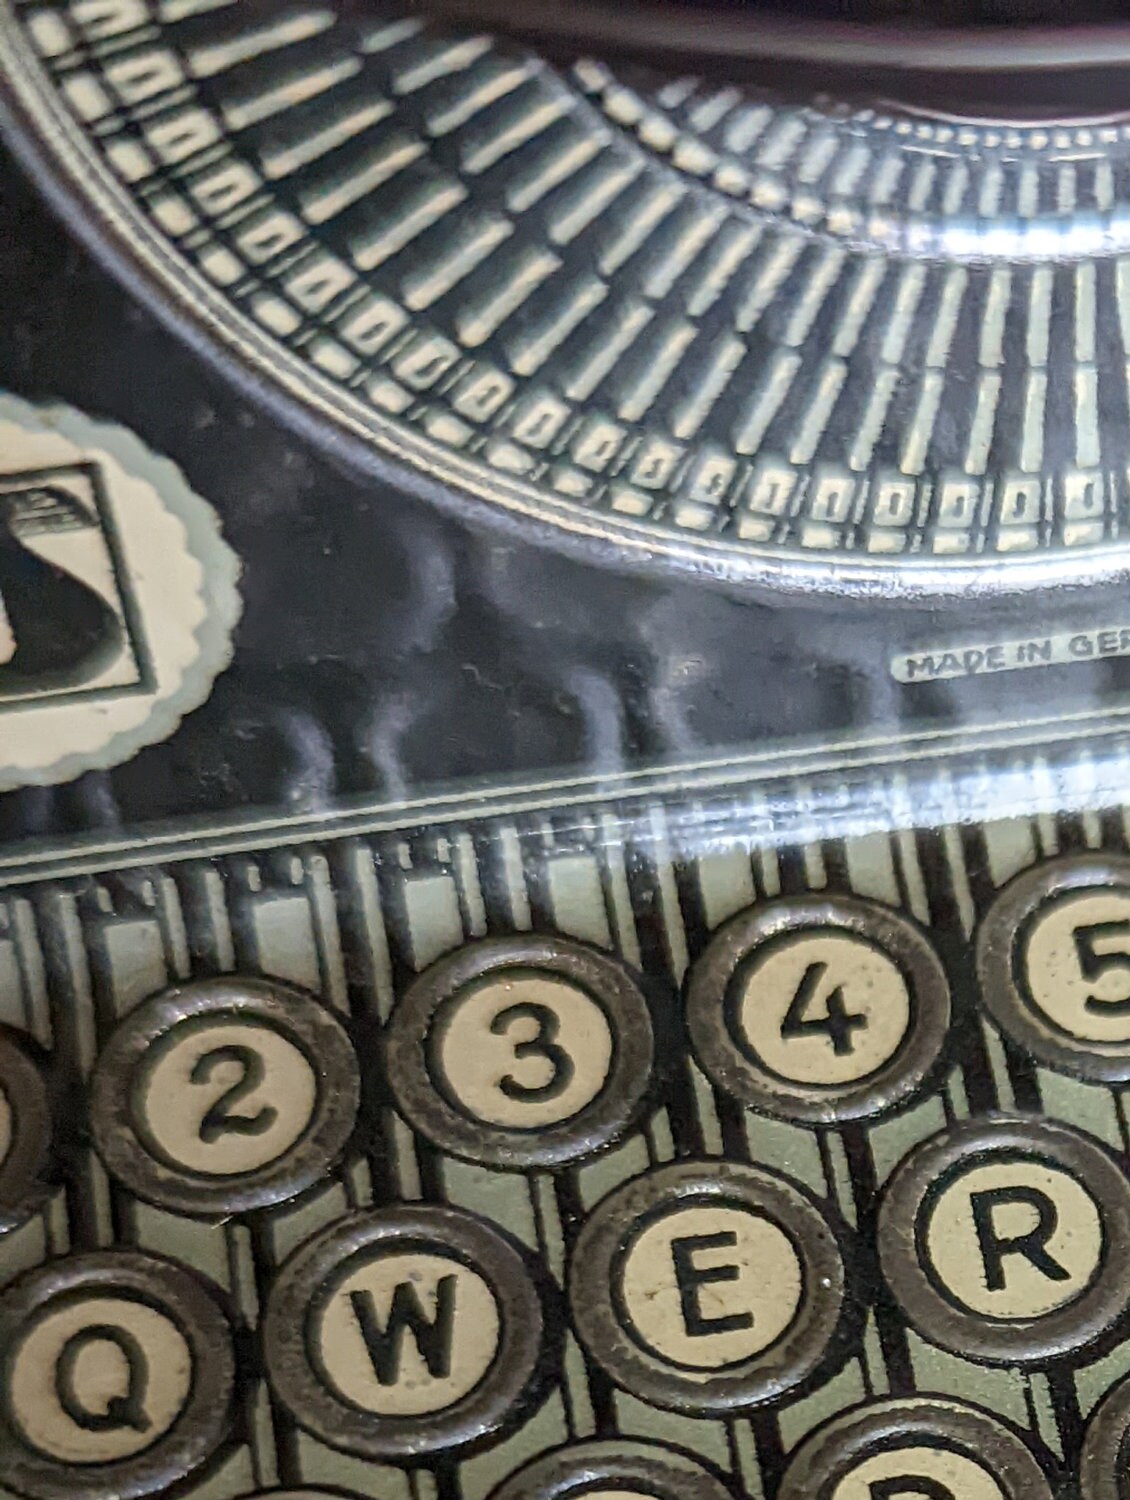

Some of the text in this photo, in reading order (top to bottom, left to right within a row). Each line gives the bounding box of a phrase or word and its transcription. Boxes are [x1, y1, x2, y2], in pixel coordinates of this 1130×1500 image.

[906, 646, 1005, 678] MADE
[1016, 640, 1051, 662] IN
[189, 1045, 277, 1143] 2
[489, 1001, 573, 1103] 3
[780, 962, 867, 1056] 4
[53, 1324, 152, 1433] Q
[347, 1274, 456, 1386] W
[670, 1231, 753, 1337] E
[970, 1186, 1070, 1291] R
